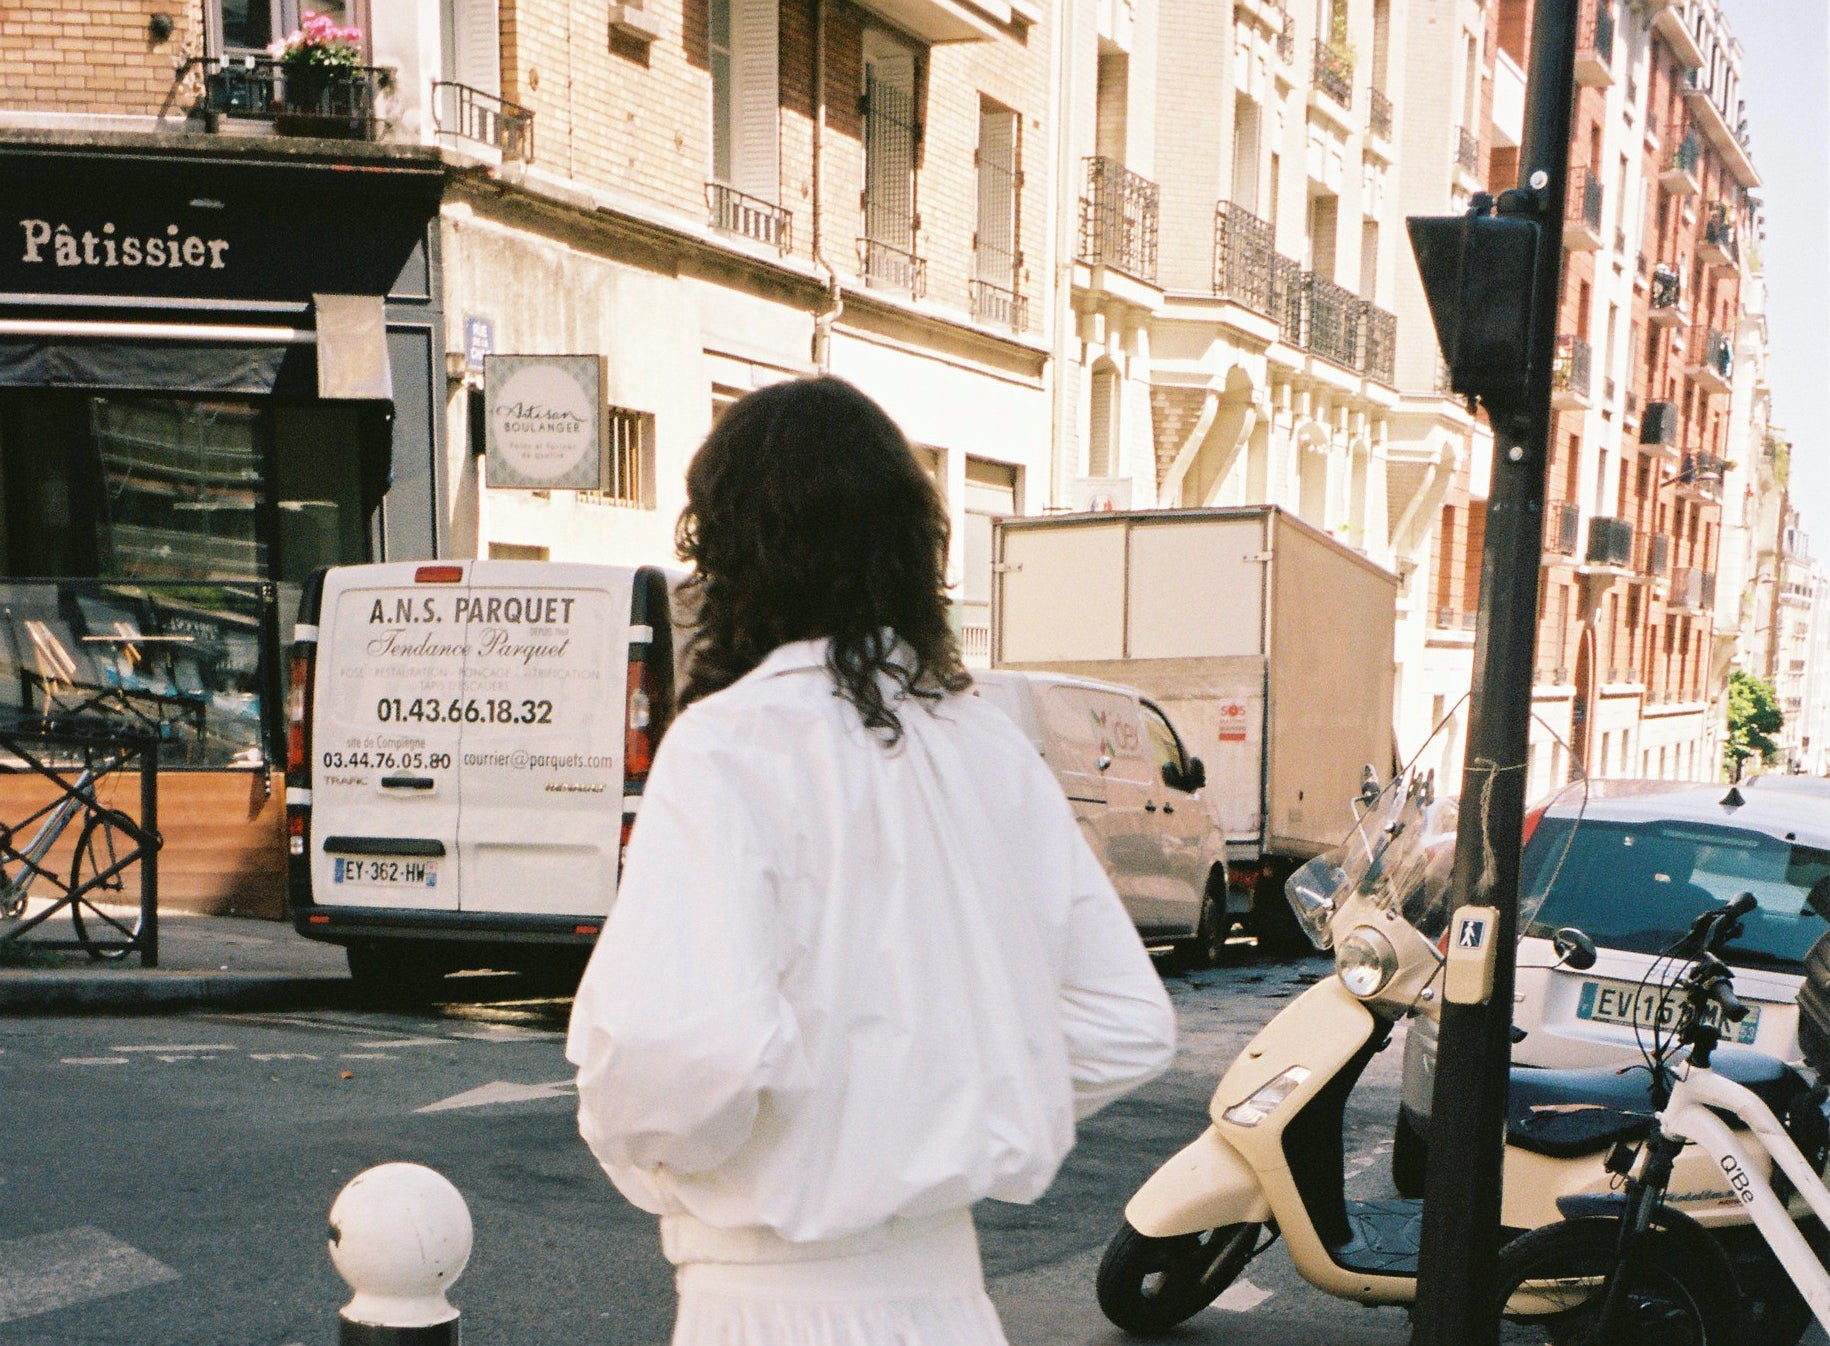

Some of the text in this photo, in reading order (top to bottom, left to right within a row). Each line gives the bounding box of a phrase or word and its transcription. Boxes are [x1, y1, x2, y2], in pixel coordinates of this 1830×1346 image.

[19, 219, 229, 269] Pâtissier
[495, 402, 585, 422] Artisan
[504, 421, 580, 433] BOULANGER
[369, 598, 575, 624] A.N.S. PARQUET
[367, 627, 570, 665] Tendance Parquet
[377, 698, 553, 724] 01.43.66.18.32
[323, 752, 451, 769] 03.44.76.05.80
[464, 749, 613, 771] courrier@parquets.com
[1720, 1155, 1754, 1203] Q'Be
